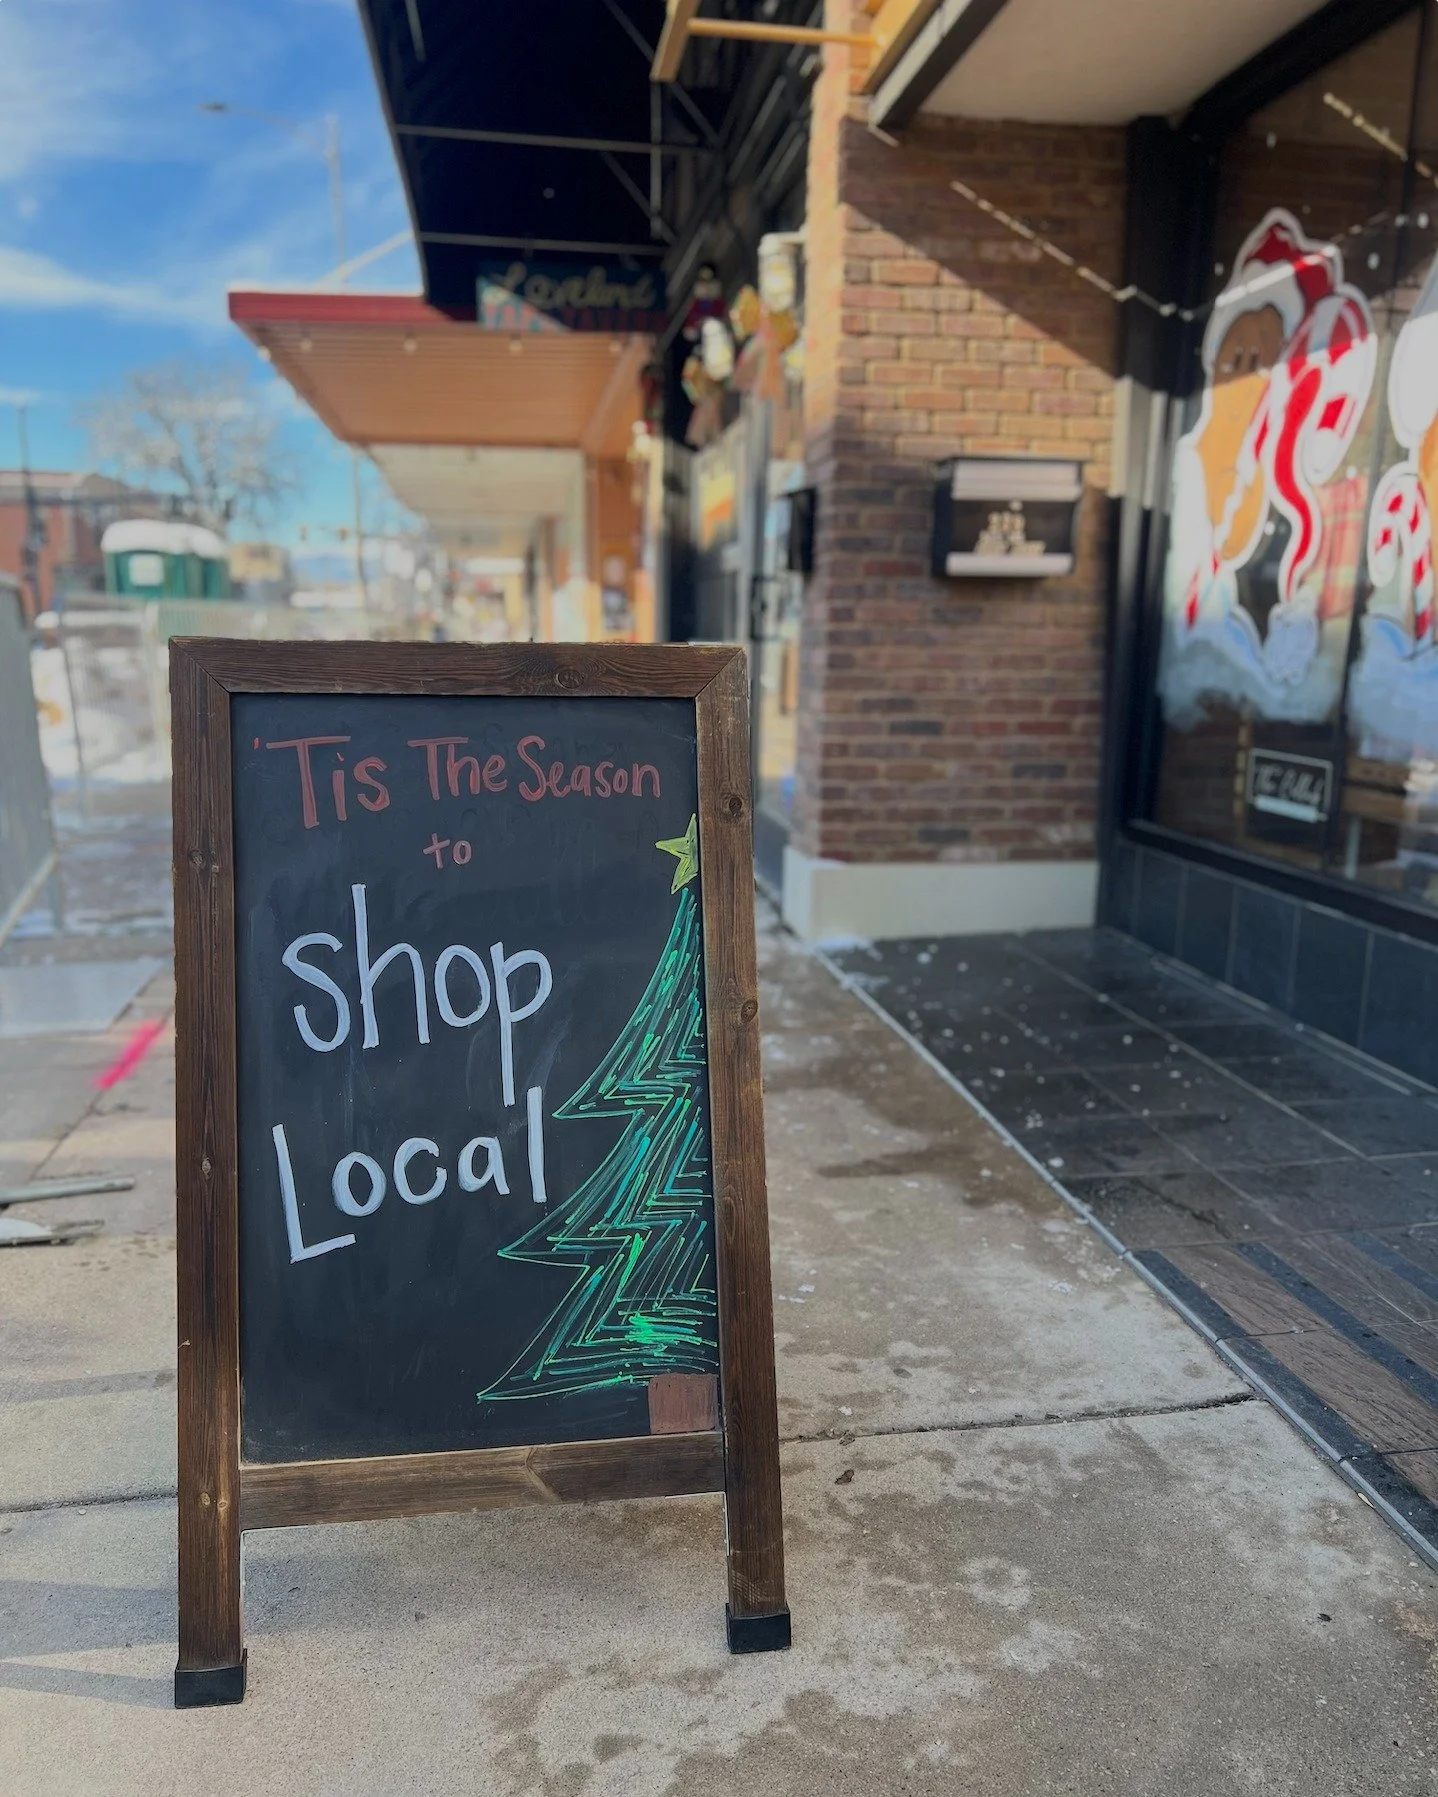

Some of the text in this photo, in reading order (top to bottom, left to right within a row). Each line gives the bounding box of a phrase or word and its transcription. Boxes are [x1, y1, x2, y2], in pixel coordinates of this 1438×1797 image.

[252, 735, 662, 829] 'Tis The Season
[422, 832, 473, 869] to
[271, 1085, 548, 1264] Local
